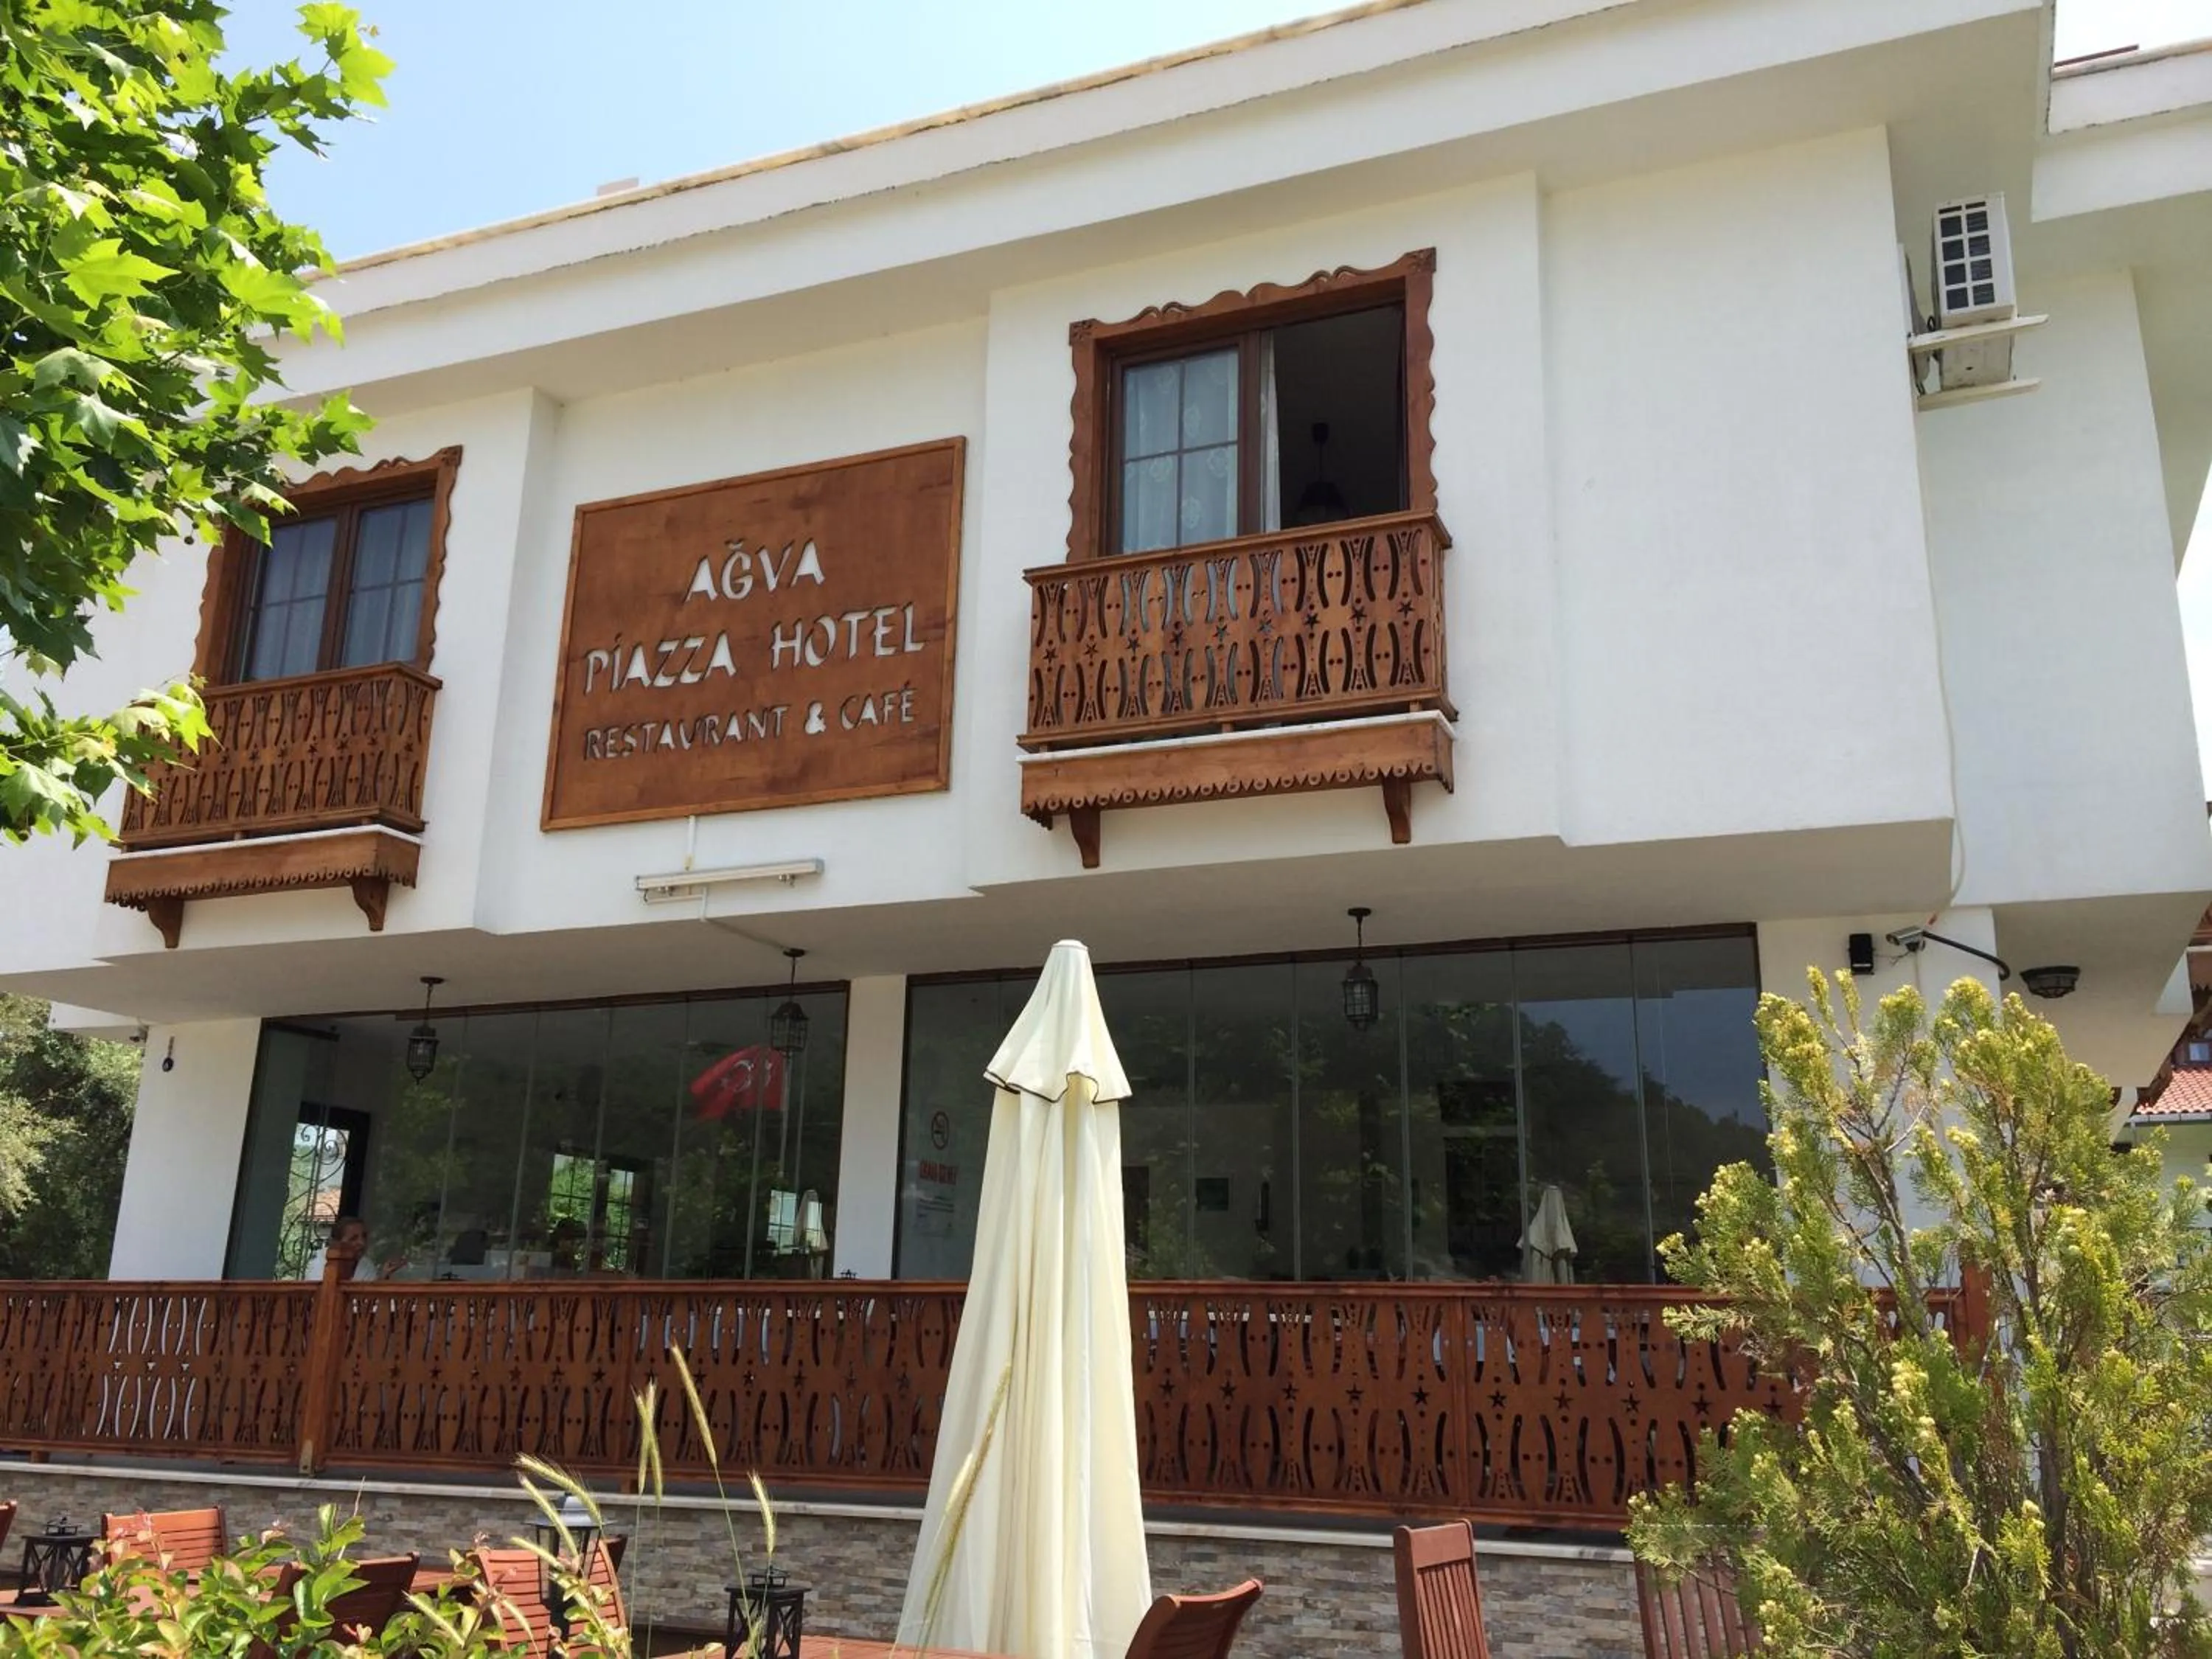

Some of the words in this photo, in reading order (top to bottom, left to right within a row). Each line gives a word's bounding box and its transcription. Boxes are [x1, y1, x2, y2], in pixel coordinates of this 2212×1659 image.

[771, 602, 928, 670] HOTEL
[583, 705, 791, 761] RESTAURANT
[804, 701, 827, 736] &
[839, 680, 919, 731] CAFÉ
